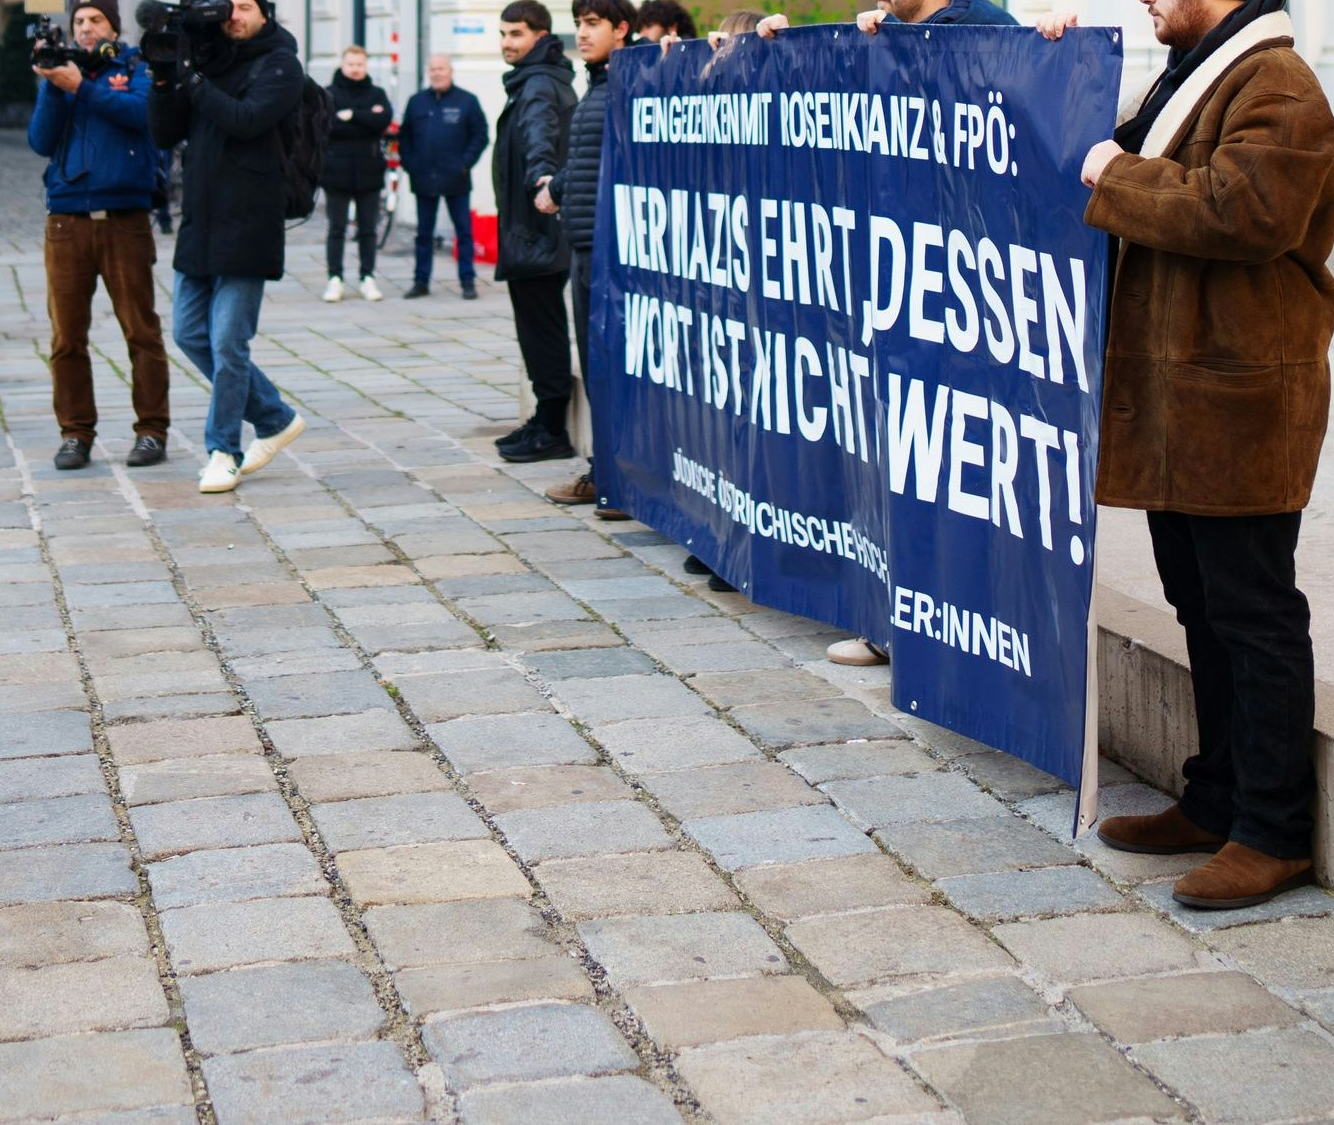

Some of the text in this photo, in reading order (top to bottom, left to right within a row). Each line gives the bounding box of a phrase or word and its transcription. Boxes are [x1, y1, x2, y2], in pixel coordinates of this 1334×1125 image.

[740, 91, 772, 146] MIT
[932, 99, 948, 165] &
[953, 90, 1018, 177] FPÖ:
[614, 183, 1089, 394] WER NAZIS EHRT, DESSEN
[624, 292, 1085, 566] WORT IST NICHT WERT!
